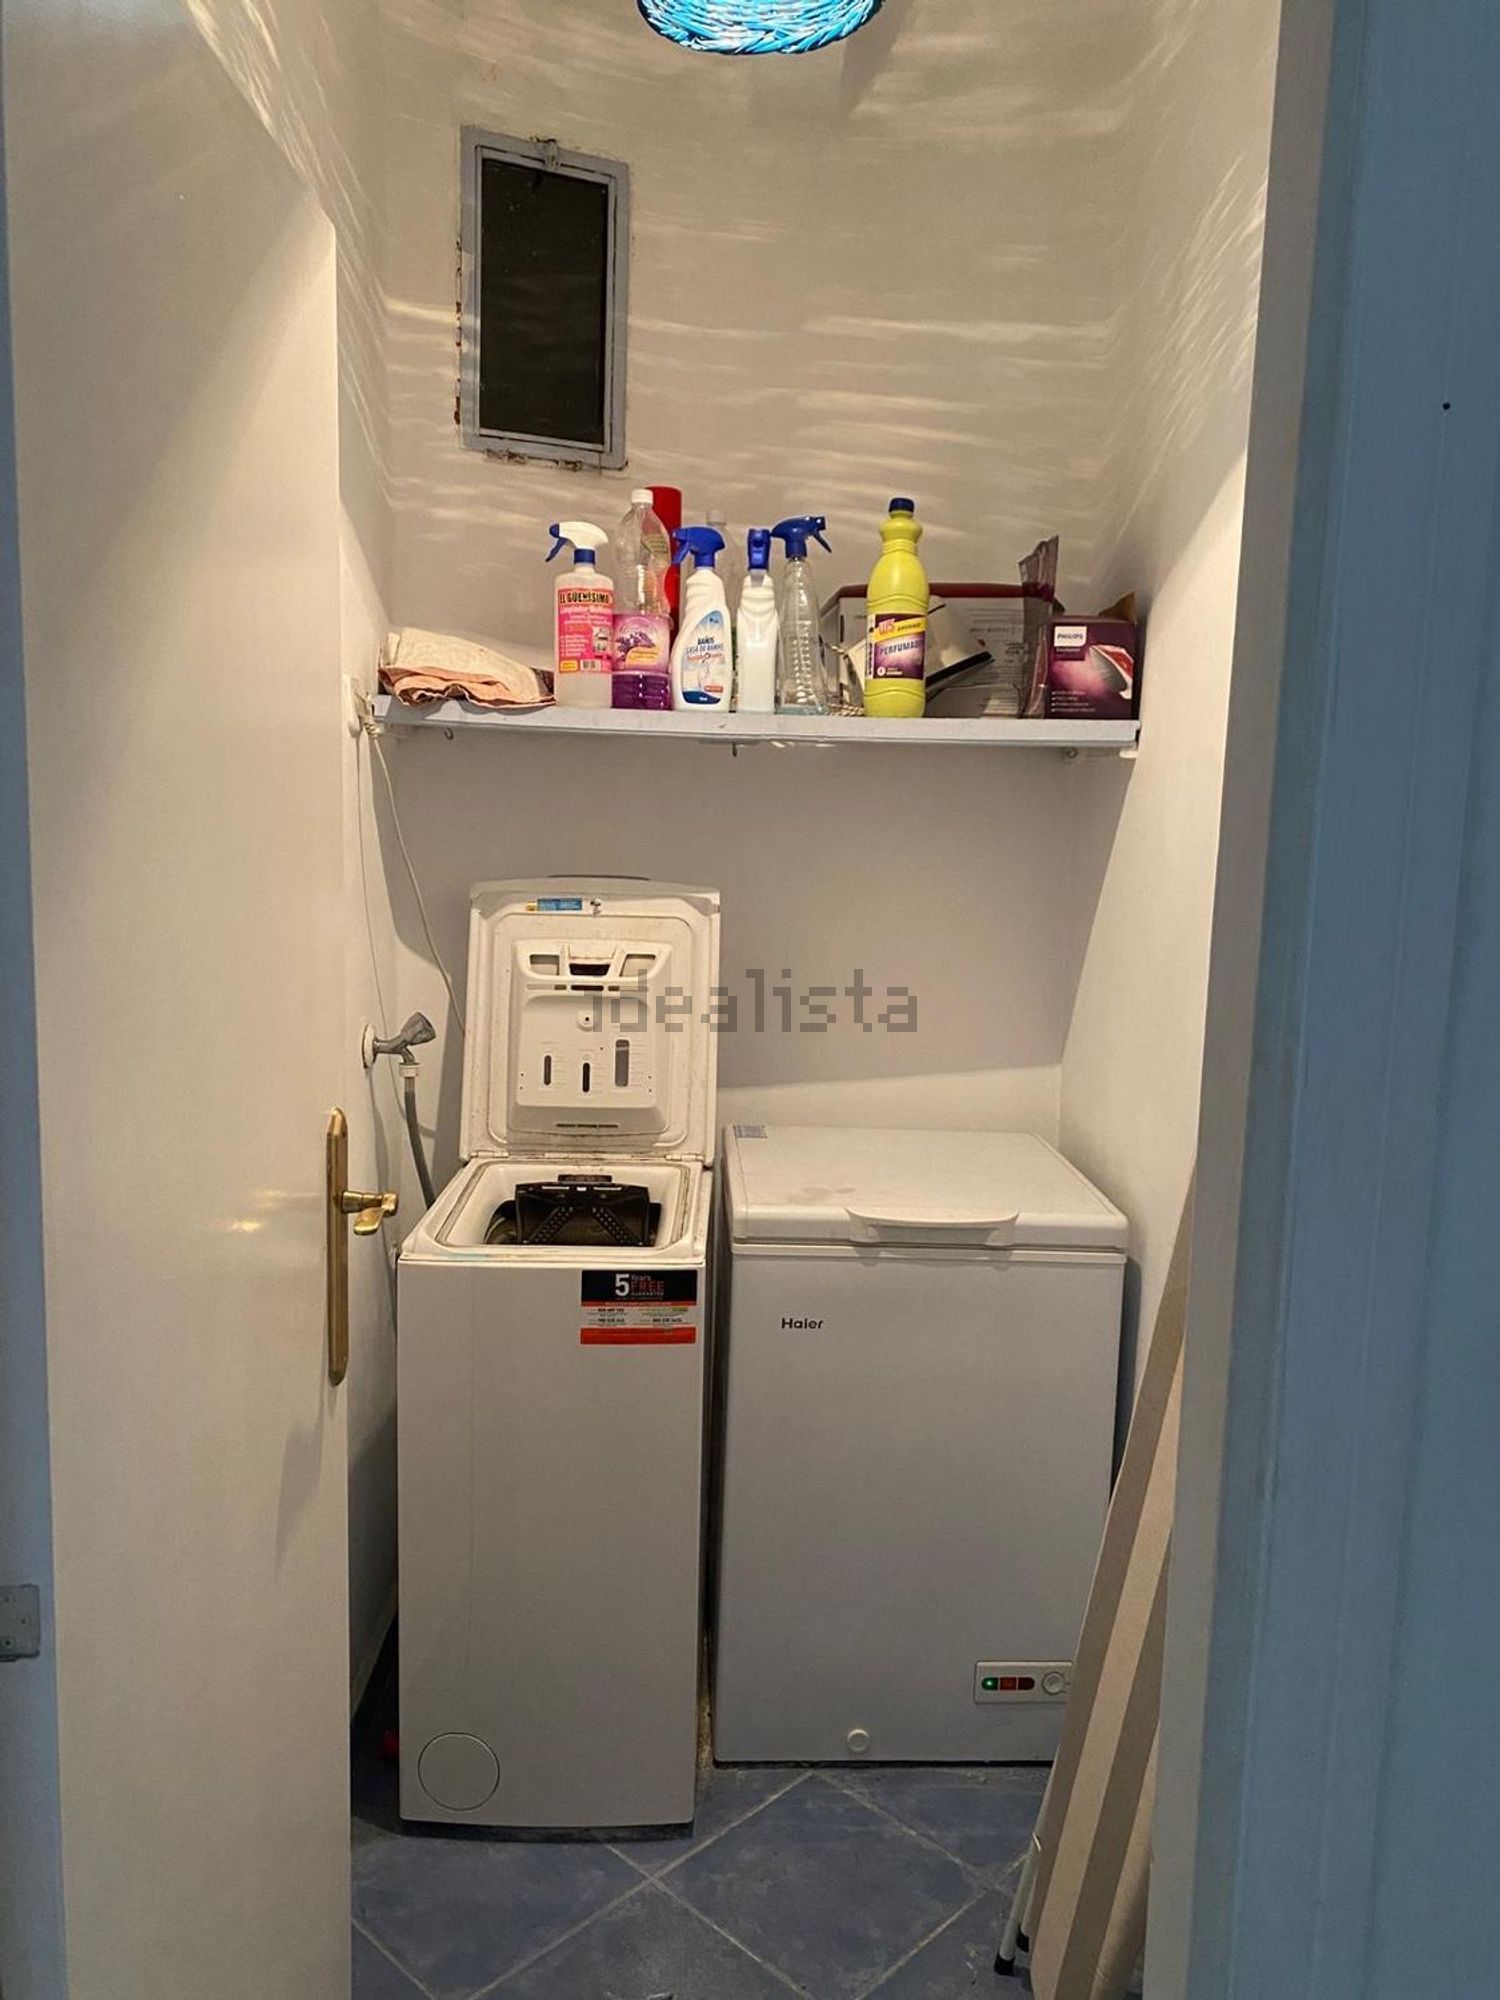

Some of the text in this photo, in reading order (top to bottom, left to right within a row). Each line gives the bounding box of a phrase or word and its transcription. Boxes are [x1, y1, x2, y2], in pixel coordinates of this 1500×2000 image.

[615, 1273, 630, 1297] 5
[631, 1281, 665, 1290] FREE
[781, 1317, 824, 1329] Haier
